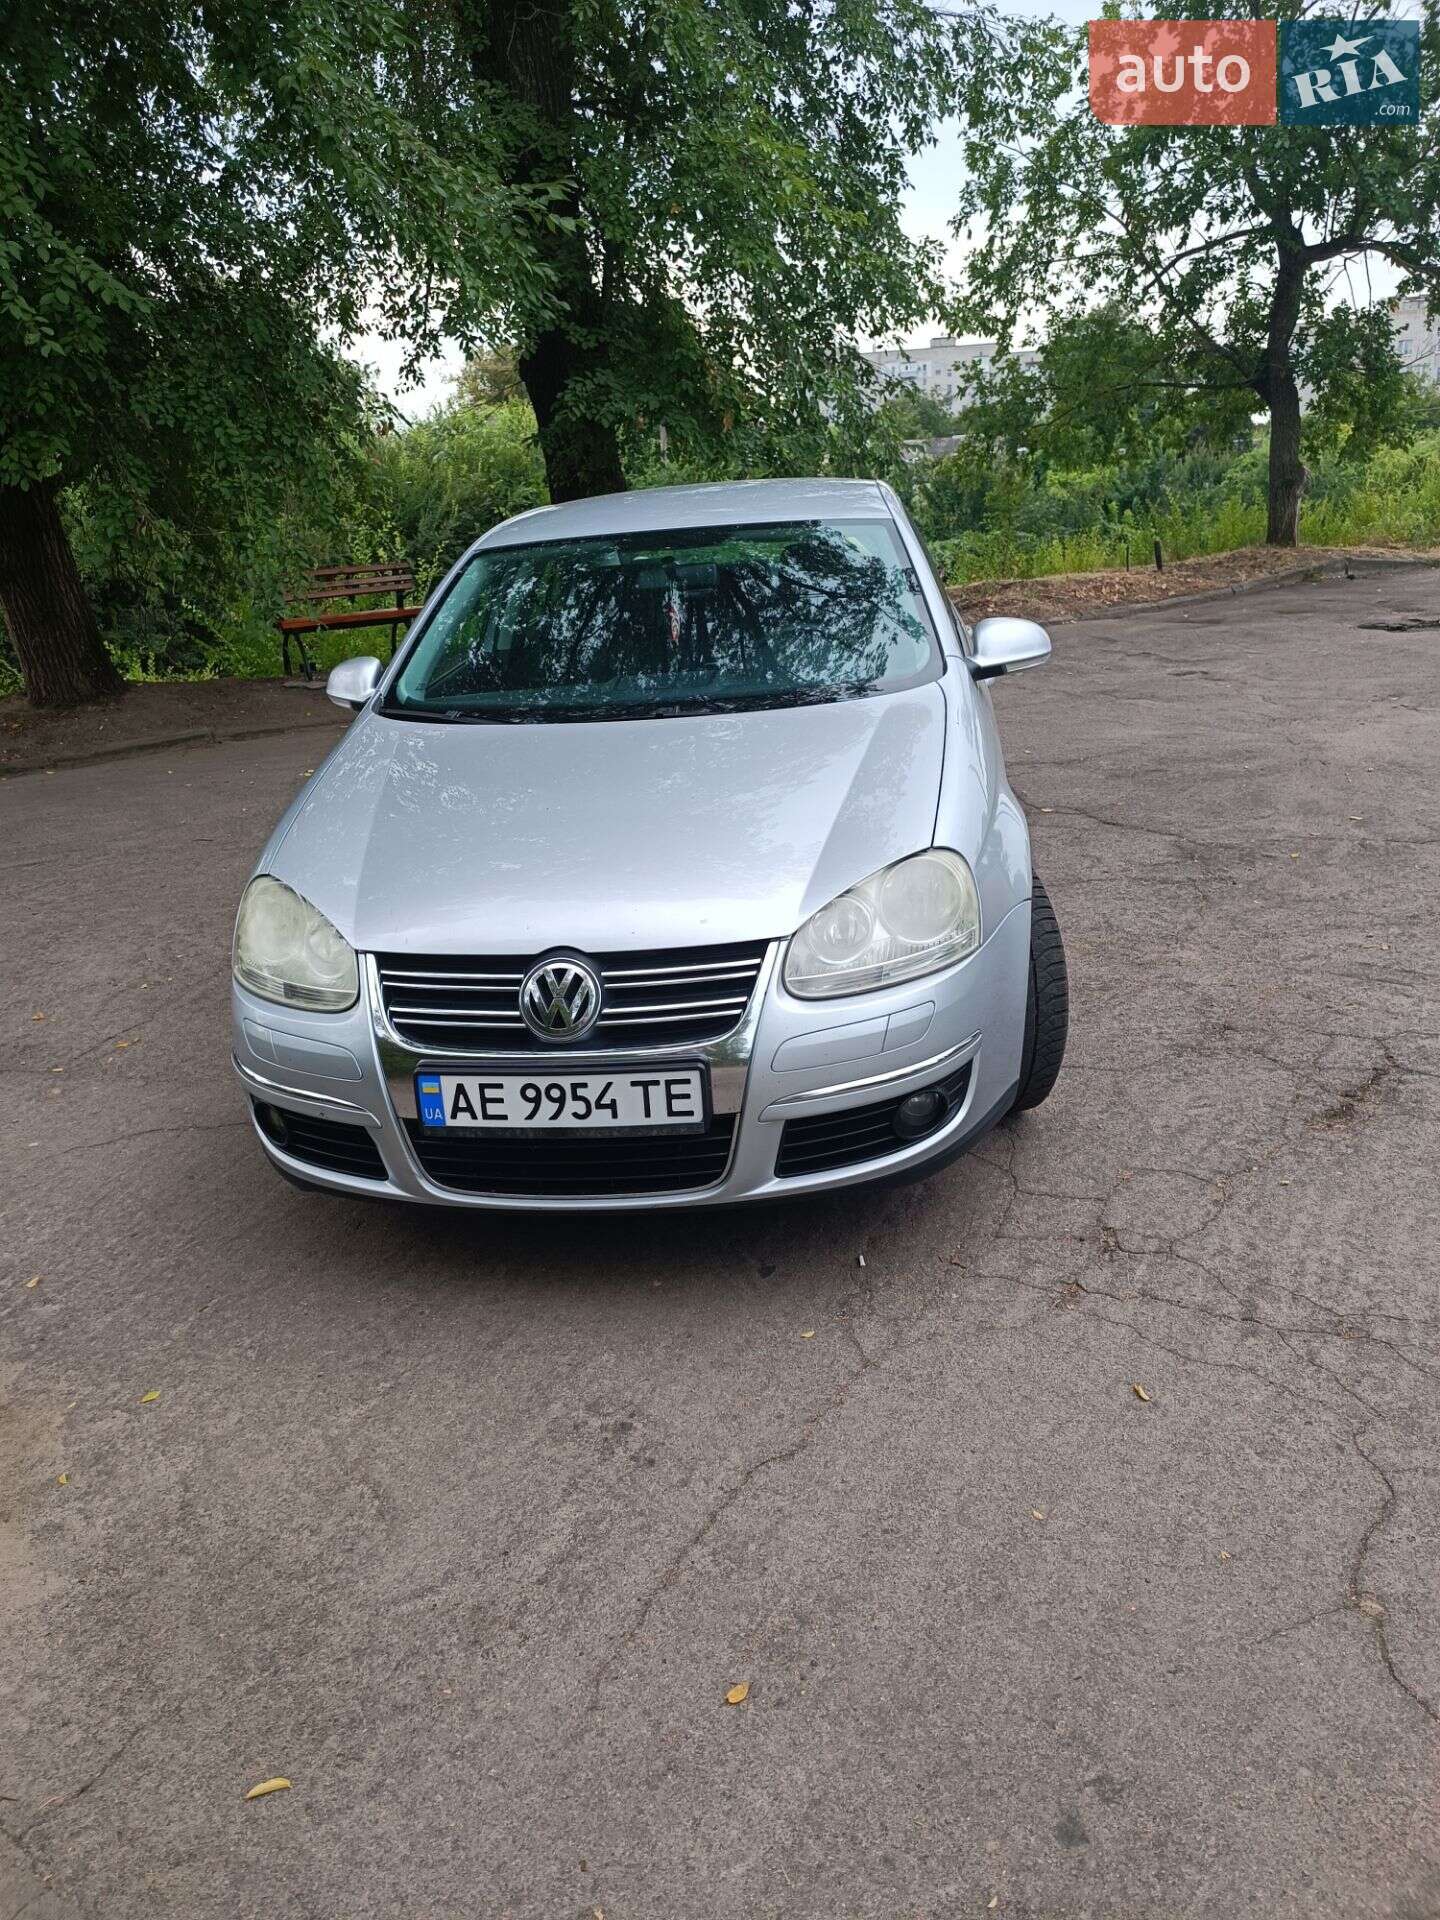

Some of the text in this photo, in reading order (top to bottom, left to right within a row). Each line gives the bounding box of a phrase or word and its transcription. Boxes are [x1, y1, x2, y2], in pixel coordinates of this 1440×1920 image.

[524, 962, 596, 1035] VW
[424, 1107, 442, 1121] UA
[450, 1078, 695, 1121] AE 9954 TE
